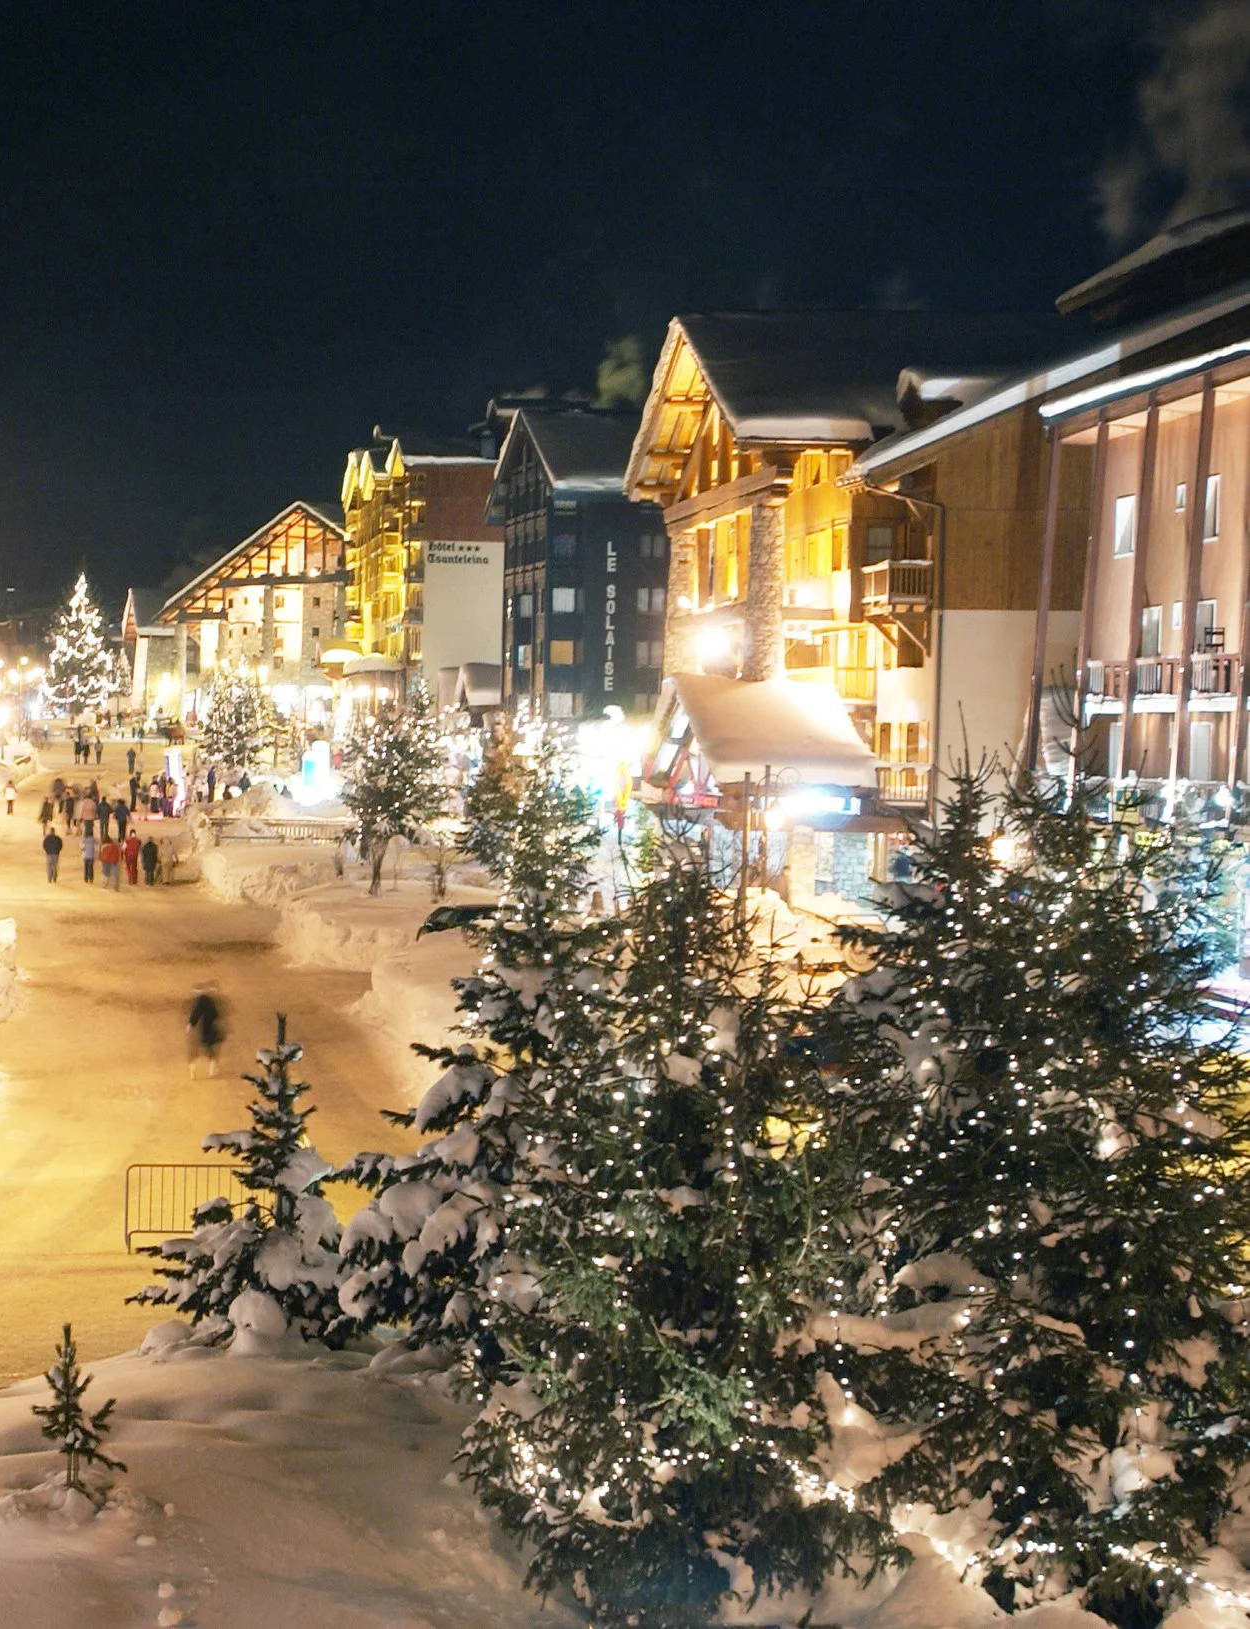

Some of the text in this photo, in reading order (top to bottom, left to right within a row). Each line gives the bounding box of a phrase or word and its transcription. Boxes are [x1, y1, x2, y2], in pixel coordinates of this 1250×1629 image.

[428, 541, 455, 551] Hôtel
[427, 553, 489, 564] Tsanteleina
[604, 541, 617, 692] LE SOLAISE
